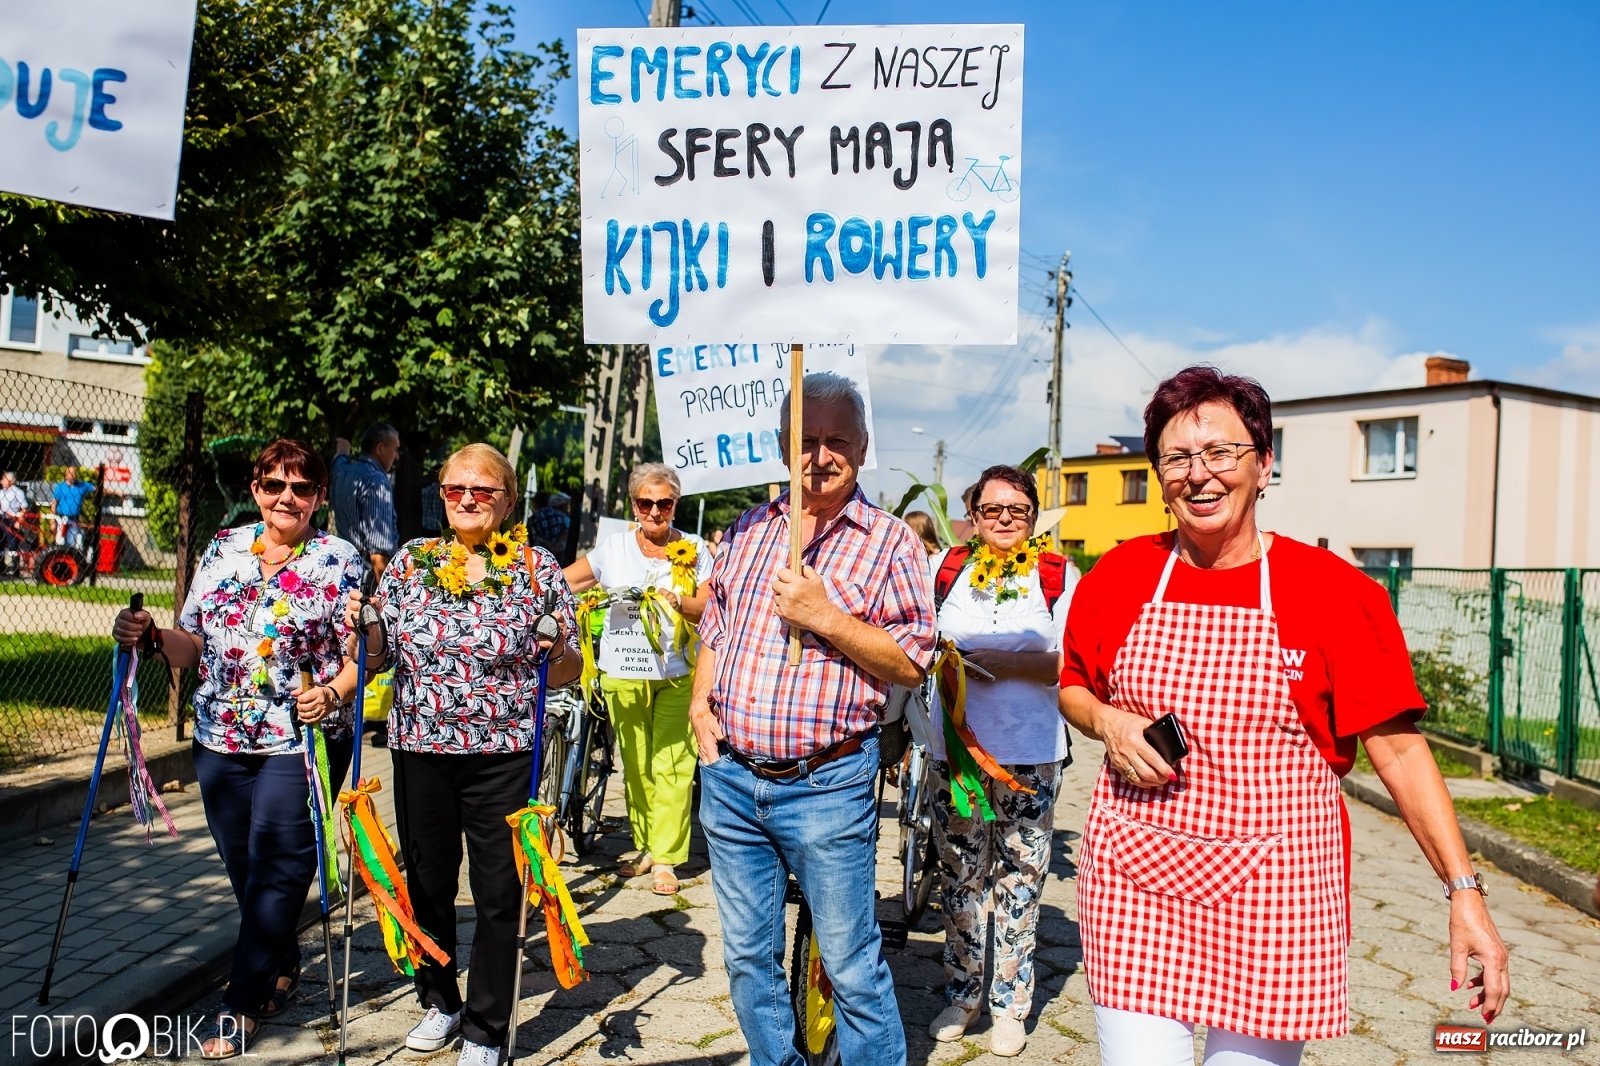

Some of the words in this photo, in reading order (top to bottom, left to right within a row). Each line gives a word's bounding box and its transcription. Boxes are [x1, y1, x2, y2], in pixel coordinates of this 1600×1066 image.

[590, 42, 801, 106] EMERYCI
[820, 43, 857, 89] Z
[873, 44, 1010, 110] NASZEJ
[654, 122, 805, 187] SFERY
[604, 218, 729, 327] KIJKI
[761, 219, 775, 287] I
[803, 209, 997, 284] ROWERY
[657, 344, 759, 377] EMERYCI
